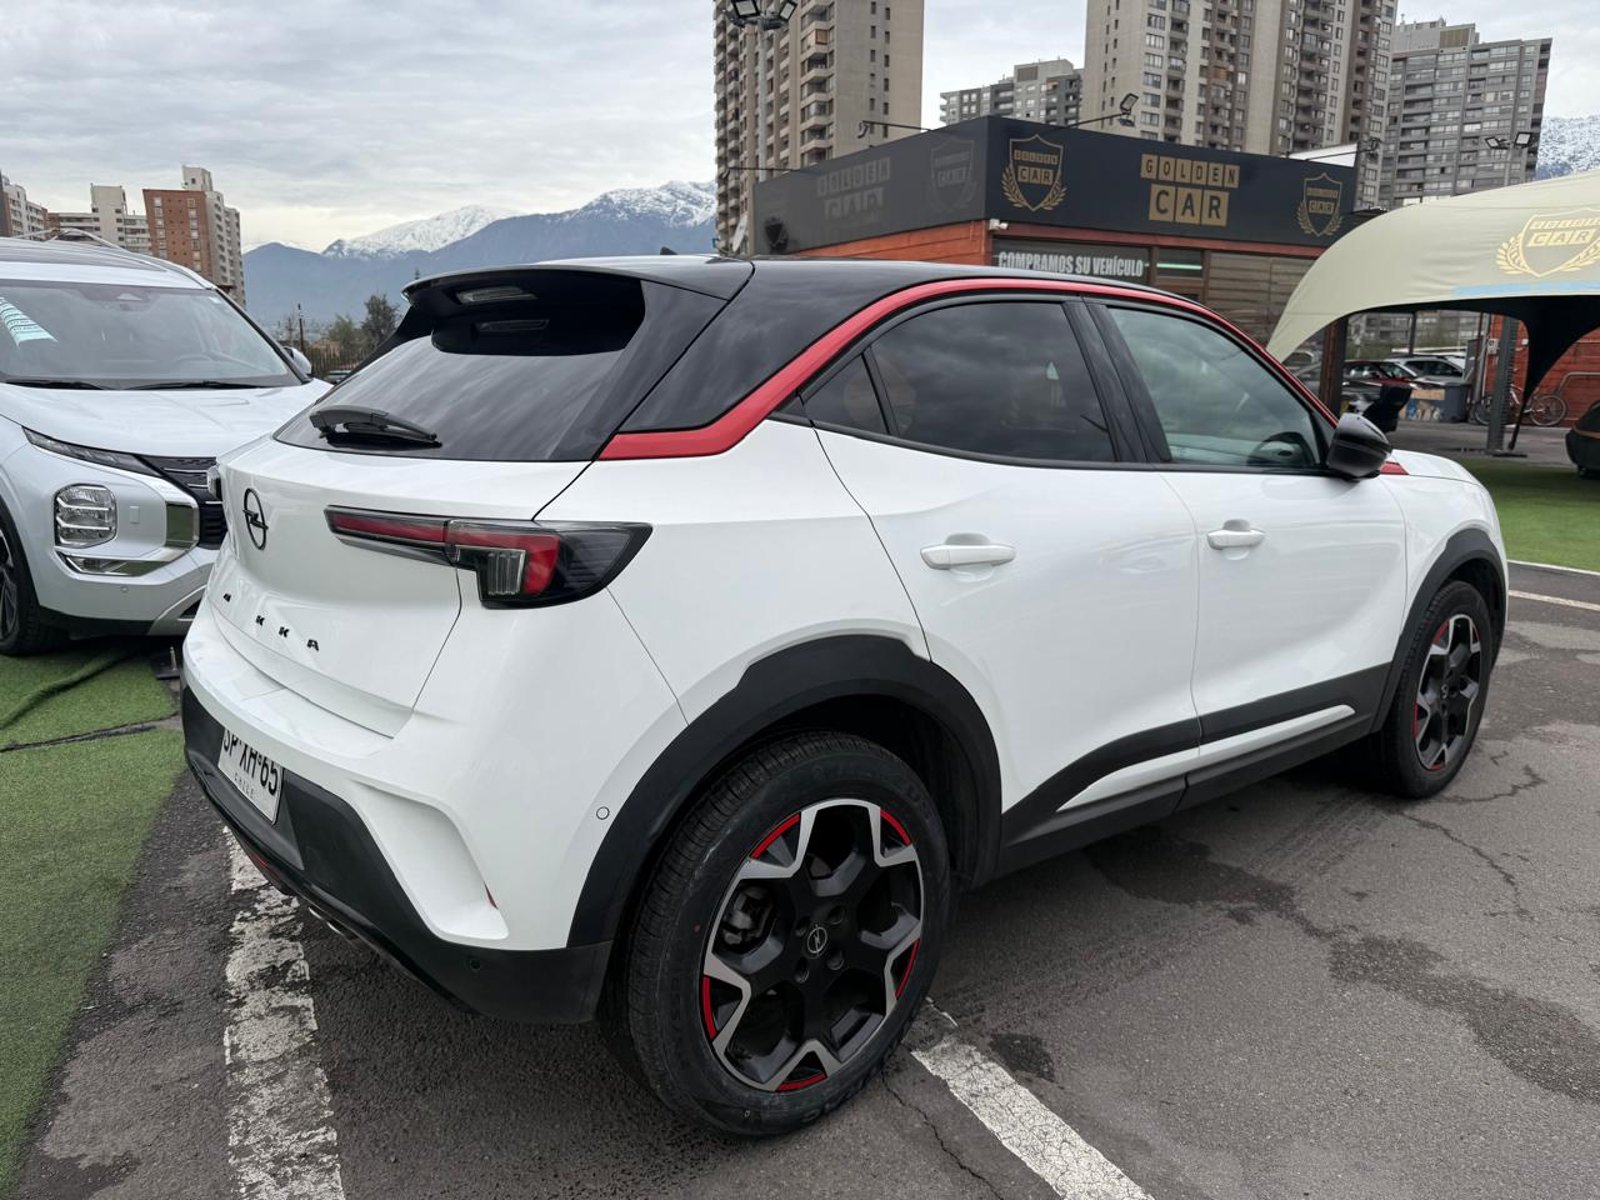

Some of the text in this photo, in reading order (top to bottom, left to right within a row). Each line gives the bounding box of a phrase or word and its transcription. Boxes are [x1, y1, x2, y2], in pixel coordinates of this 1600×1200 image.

[1020, 167, 1052, 184] CAR
[1145, 158, 1236, 185] GOLDEN
[1154, 188, 1223, 221] CAR
[1533, 230, 1591, 245] CAR
[999, 252, 1143, 277] COMPRAMOS SU VEHÍCULO
